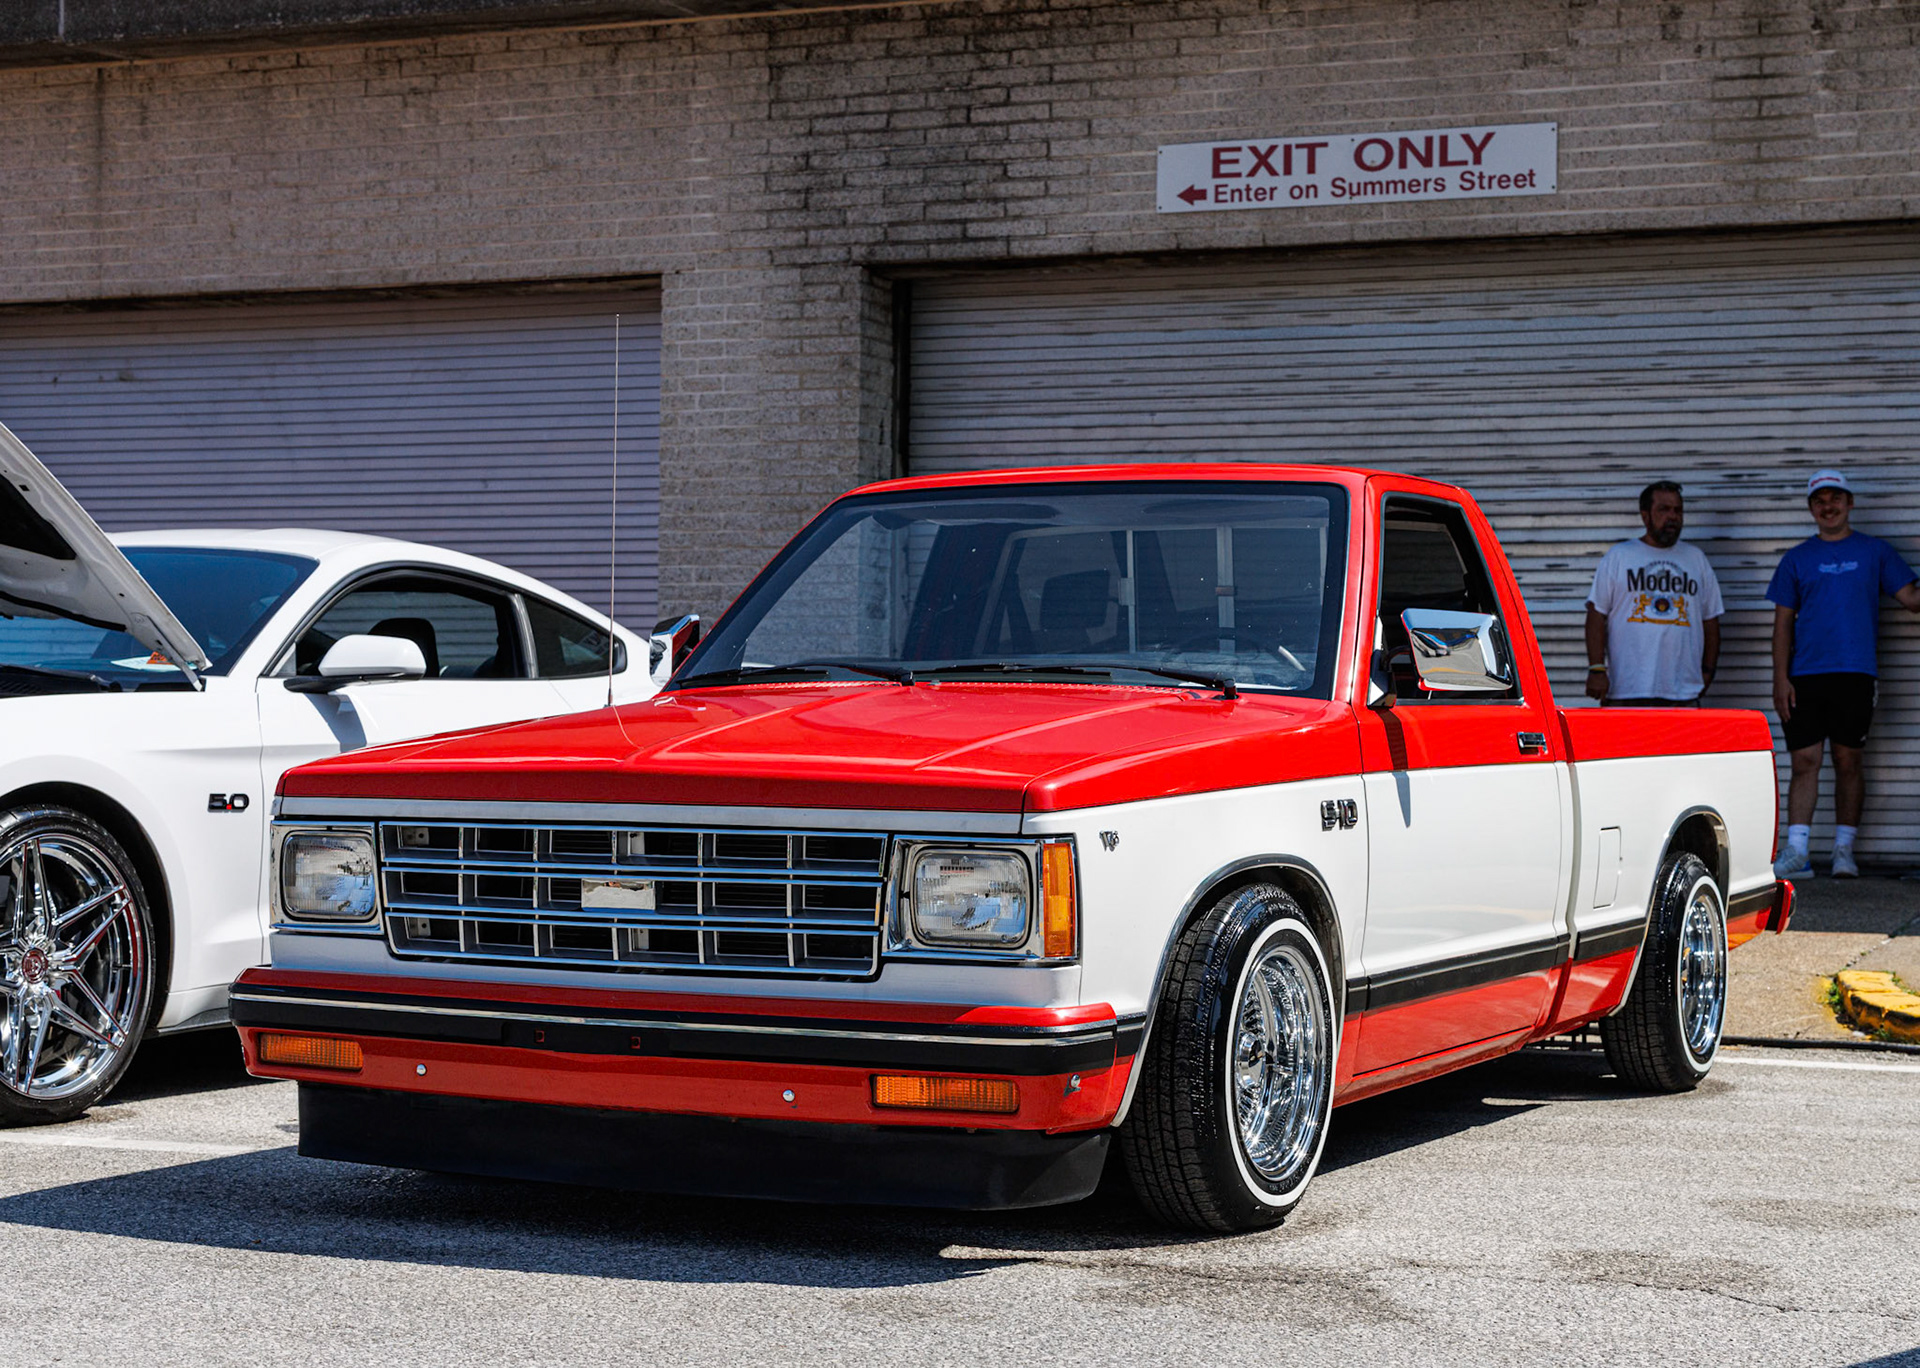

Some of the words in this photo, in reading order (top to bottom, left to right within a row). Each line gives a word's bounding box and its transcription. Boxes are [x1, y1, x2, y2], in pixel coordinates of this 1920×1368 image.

[1211, 142, 1329, 179] EXIT
[1353, 132, 1496, 173] ONLY
[1214, 183, 1278, 204] Enter
[1289, 185, 1319, 200] on
[1331, 172, 1446, 197] Summers
[1459, 168, 1537, 191] Street
[1627, 567, 1698, 596] Modelo
[208, 793, 249, 811] 5.0
